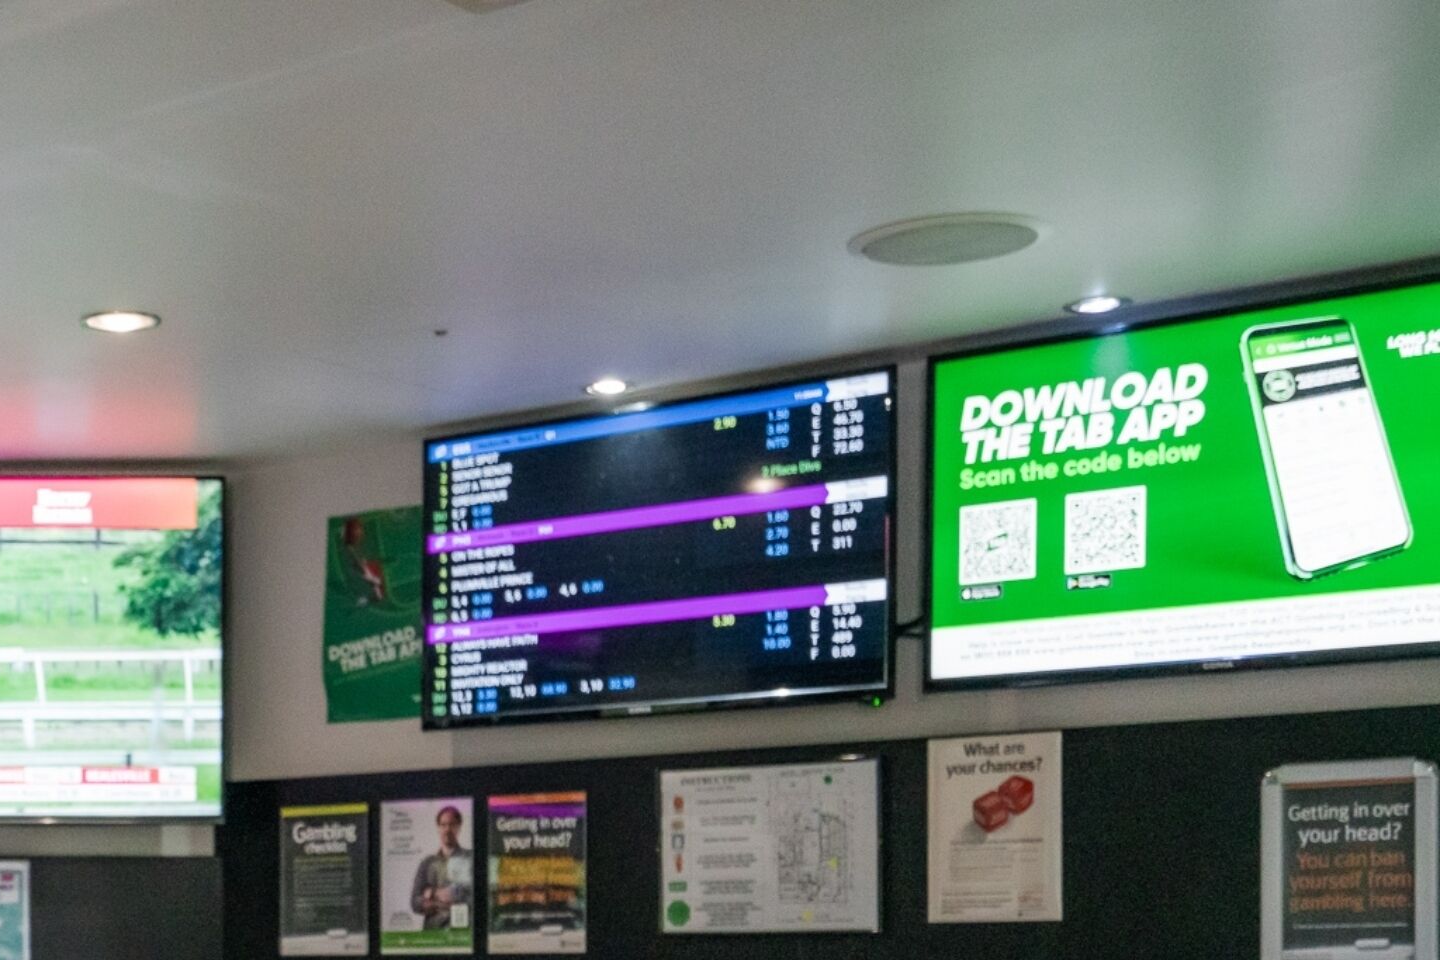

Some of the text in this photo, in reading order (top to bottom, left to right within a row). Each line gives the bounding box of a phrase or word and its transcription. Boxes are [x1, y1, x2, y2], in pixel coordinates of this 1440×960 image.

[960, 363, 1208, 432] DOWNLOAD
[961, 399, 1206, 465] THE TAB APP
[959, 442, 1202, 490] Scan the code below
[328, 626, 415, 661] DOWNLOAD
[340, 654, 367, 674] THE
[964, 743, 1025, 757] What are
[946, 757, 1043, 780] your chances?
[1288, 802, 1410, 822] Getting in over
[496, 815, 578, 833] Getting in over
[1298, 822, 1402, 848] your head?
[503, 831, 572, 853] your head?
[1297, 852, 1329, 869] You
[1333, 853, 1368, 868] can
